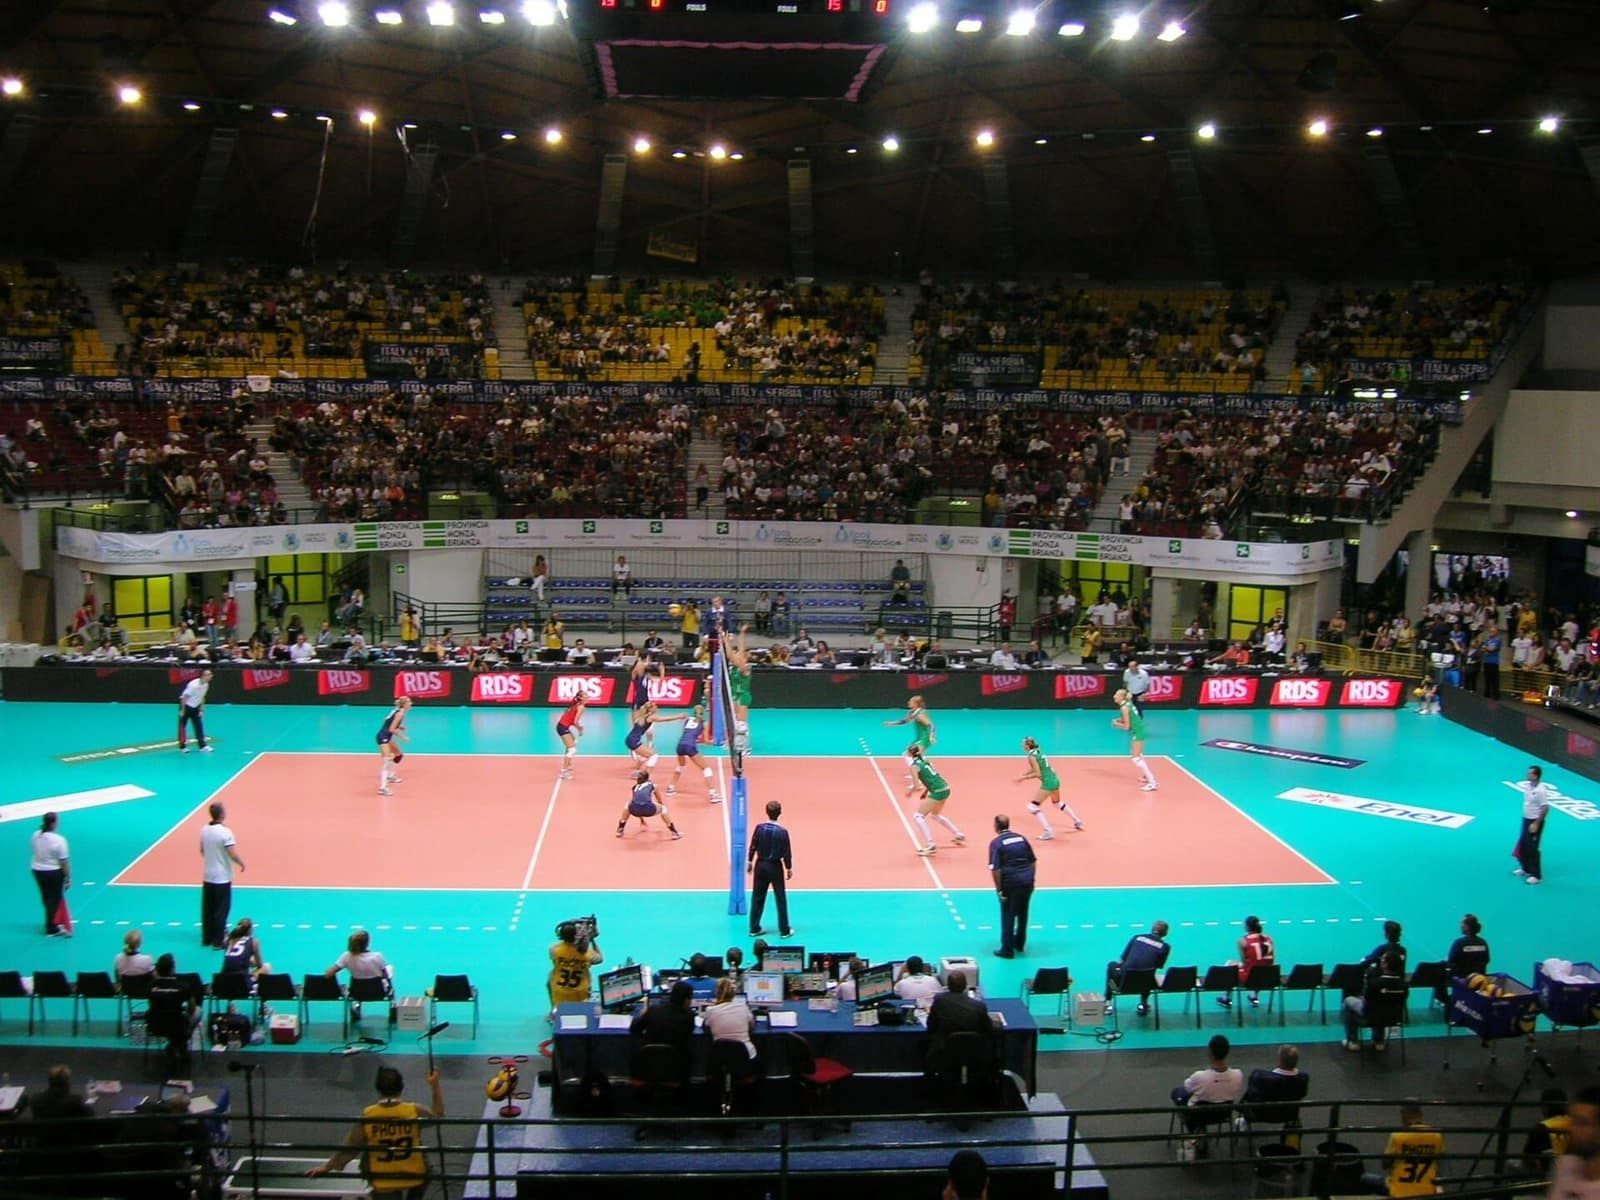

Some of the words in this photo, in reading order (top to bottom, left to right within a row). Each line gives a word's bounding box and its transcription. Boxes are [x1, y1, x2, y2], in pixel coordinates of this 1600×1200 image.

[379, 522, 420, 530] PROVINCIA
[447, 521, 488, 529] PROVINCIA
[380, 531, 406, 539] MONZA
[448, 529, 475, 537] MONZA
[1031, 531, 1074, 540] PROVINCIA
[1100, 534, 1143, 544] PROVINCIA
[380, 540, 412, 548] BRIANZA
[448, 538, 480, 546] BRIANZA
[1031, 540, 1060, 548] MONZA
[1100, 544, 1128, 553] MONZA
[1031, 548, 1064, 557] BRIANZA
[1100, 552, 1132, 561] BRIANZA
[328, 670, 362, 689] RDS
[404, 672, 442, 692] RDS
[480, 675, 522, 697] RDS
[1065, 675, 1098, 693] RDS
[1148, 676, 1174, 695] DS
[557, 677, 602, 699] RDS
[1208, 678, 1248, 699] RDS
[1279, 679, 1320, 700] RDS
[1349, 680, 1390, 700] RDS
[1356, 802, 1454, 823] Enel
[557, 969, 582, 988] 35
[371, 1122, 412, 1137] PHOTO
[1398, 1160, 1434, 1184] 37
